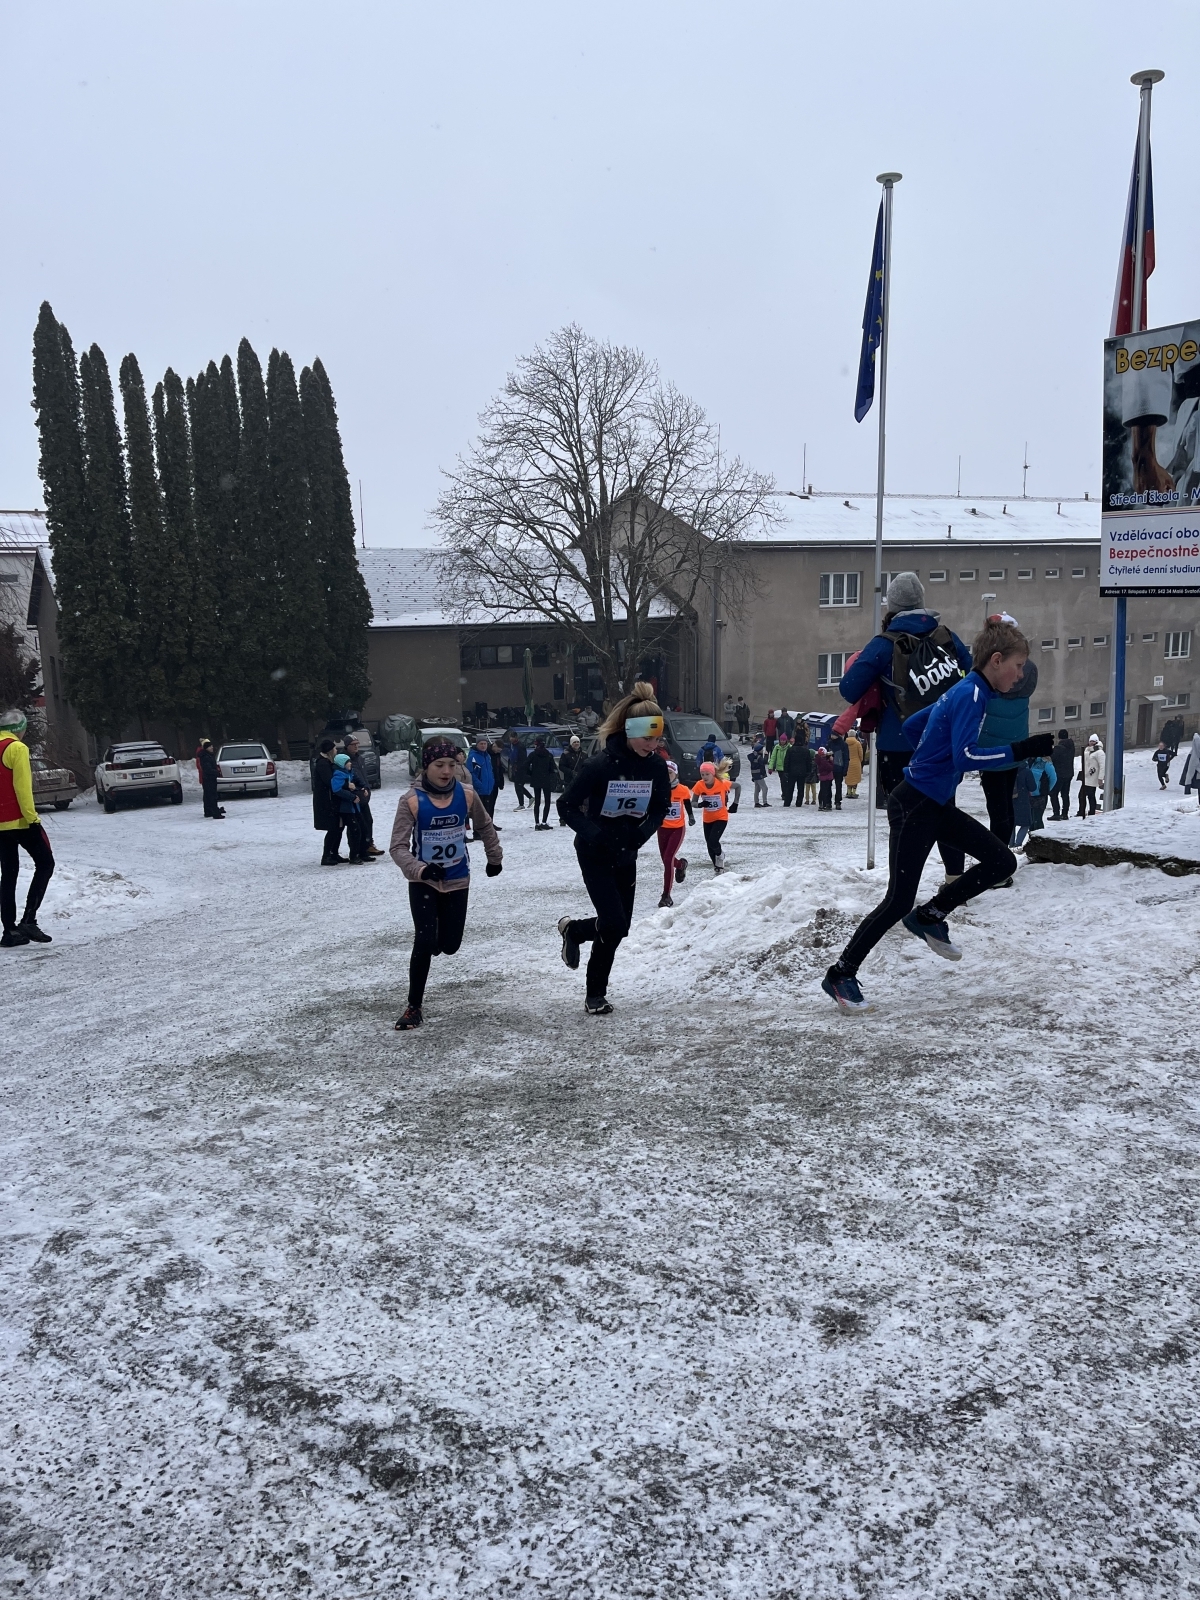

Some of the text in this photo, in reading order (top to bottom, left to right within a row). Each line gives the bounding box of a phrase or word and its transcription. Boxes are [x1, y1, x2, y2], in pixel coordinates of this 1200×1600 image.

[1115, 340, 1200, 374] Bezpe
[1109, 489, 1148, 506] Střední
[1149, 489, 1180, 503] škola
[1109, 527, 1200, 541] Vzdělávací obo
[1109, 544, 1200, 561] Bezpečnostně
[1108, 564, 1141, 576] Čtyřleté
[1143, 564, 1168, 574] denní
[617, 797, 638, 810] 16
[432, 843, 457, 860] 20
